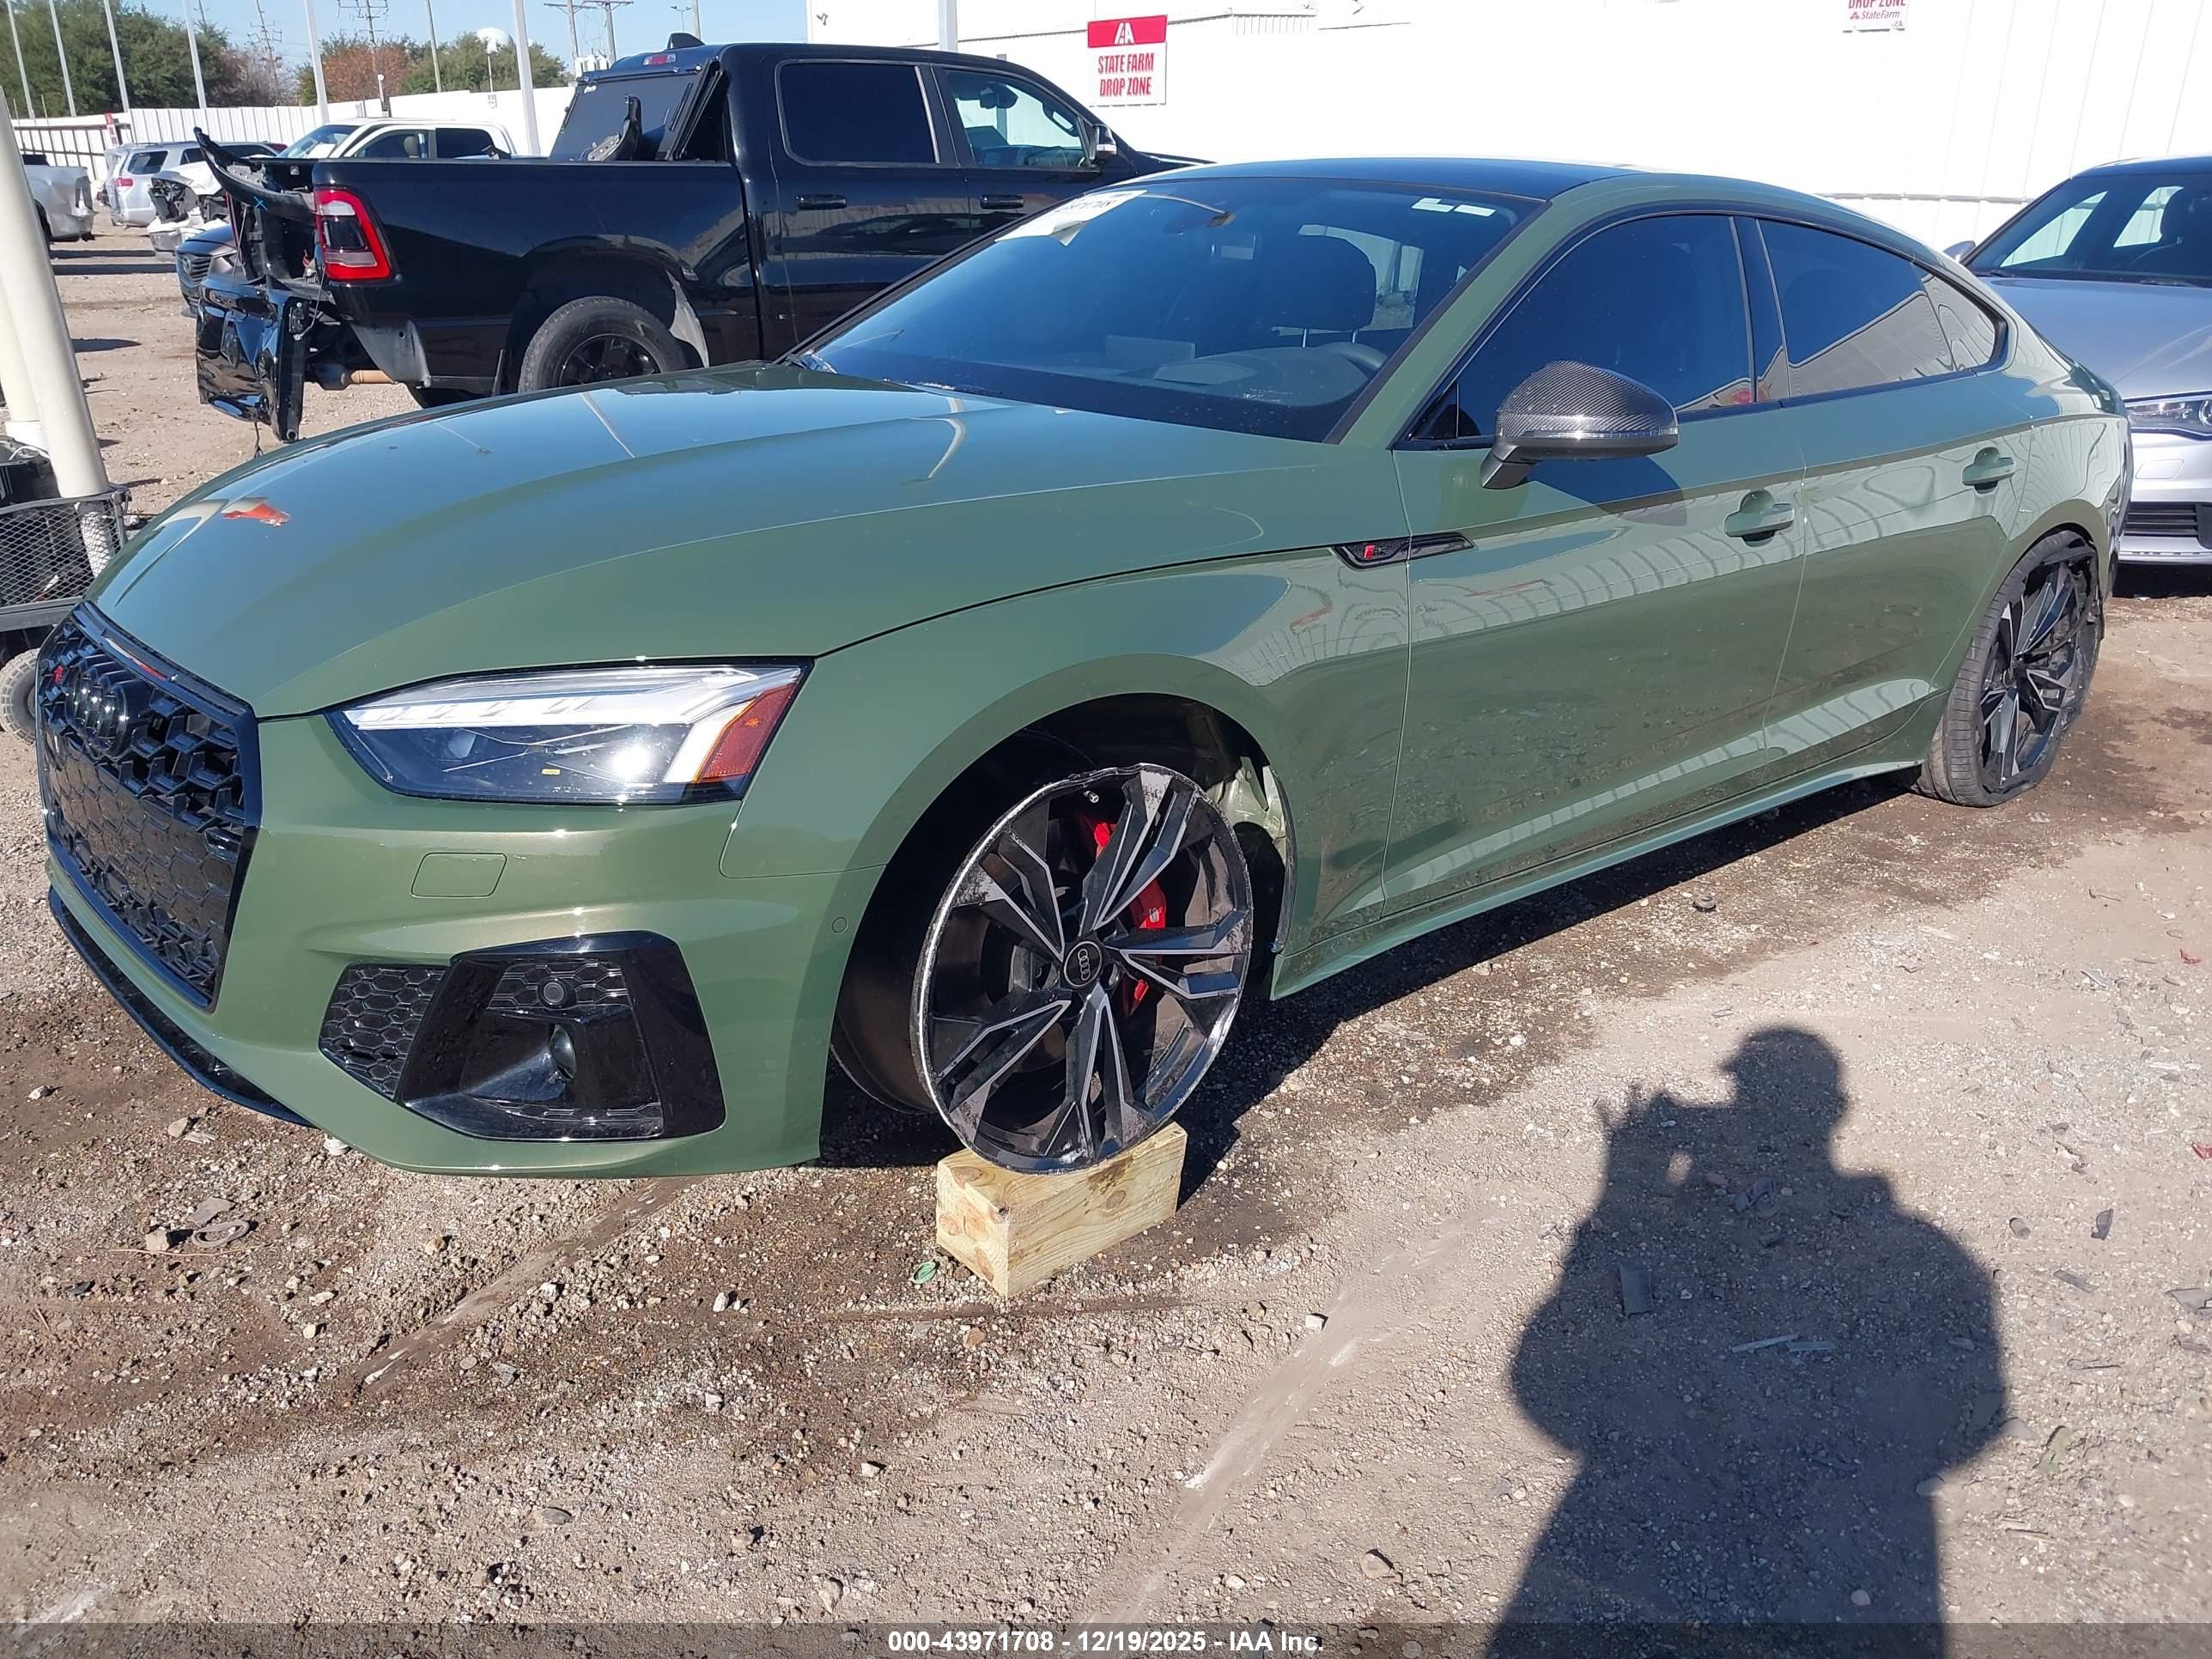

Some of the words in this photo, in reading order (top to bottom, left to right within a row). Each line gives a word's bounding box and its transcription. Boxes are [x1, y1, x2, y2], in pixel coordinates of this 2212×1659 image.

[1098, 54, 1125, 75] STATE
[1127, 52, 1154, 72] FARM
[1100, 78, 1125, 97] DROP
[1127, 76, 1152, 95] ZONE
